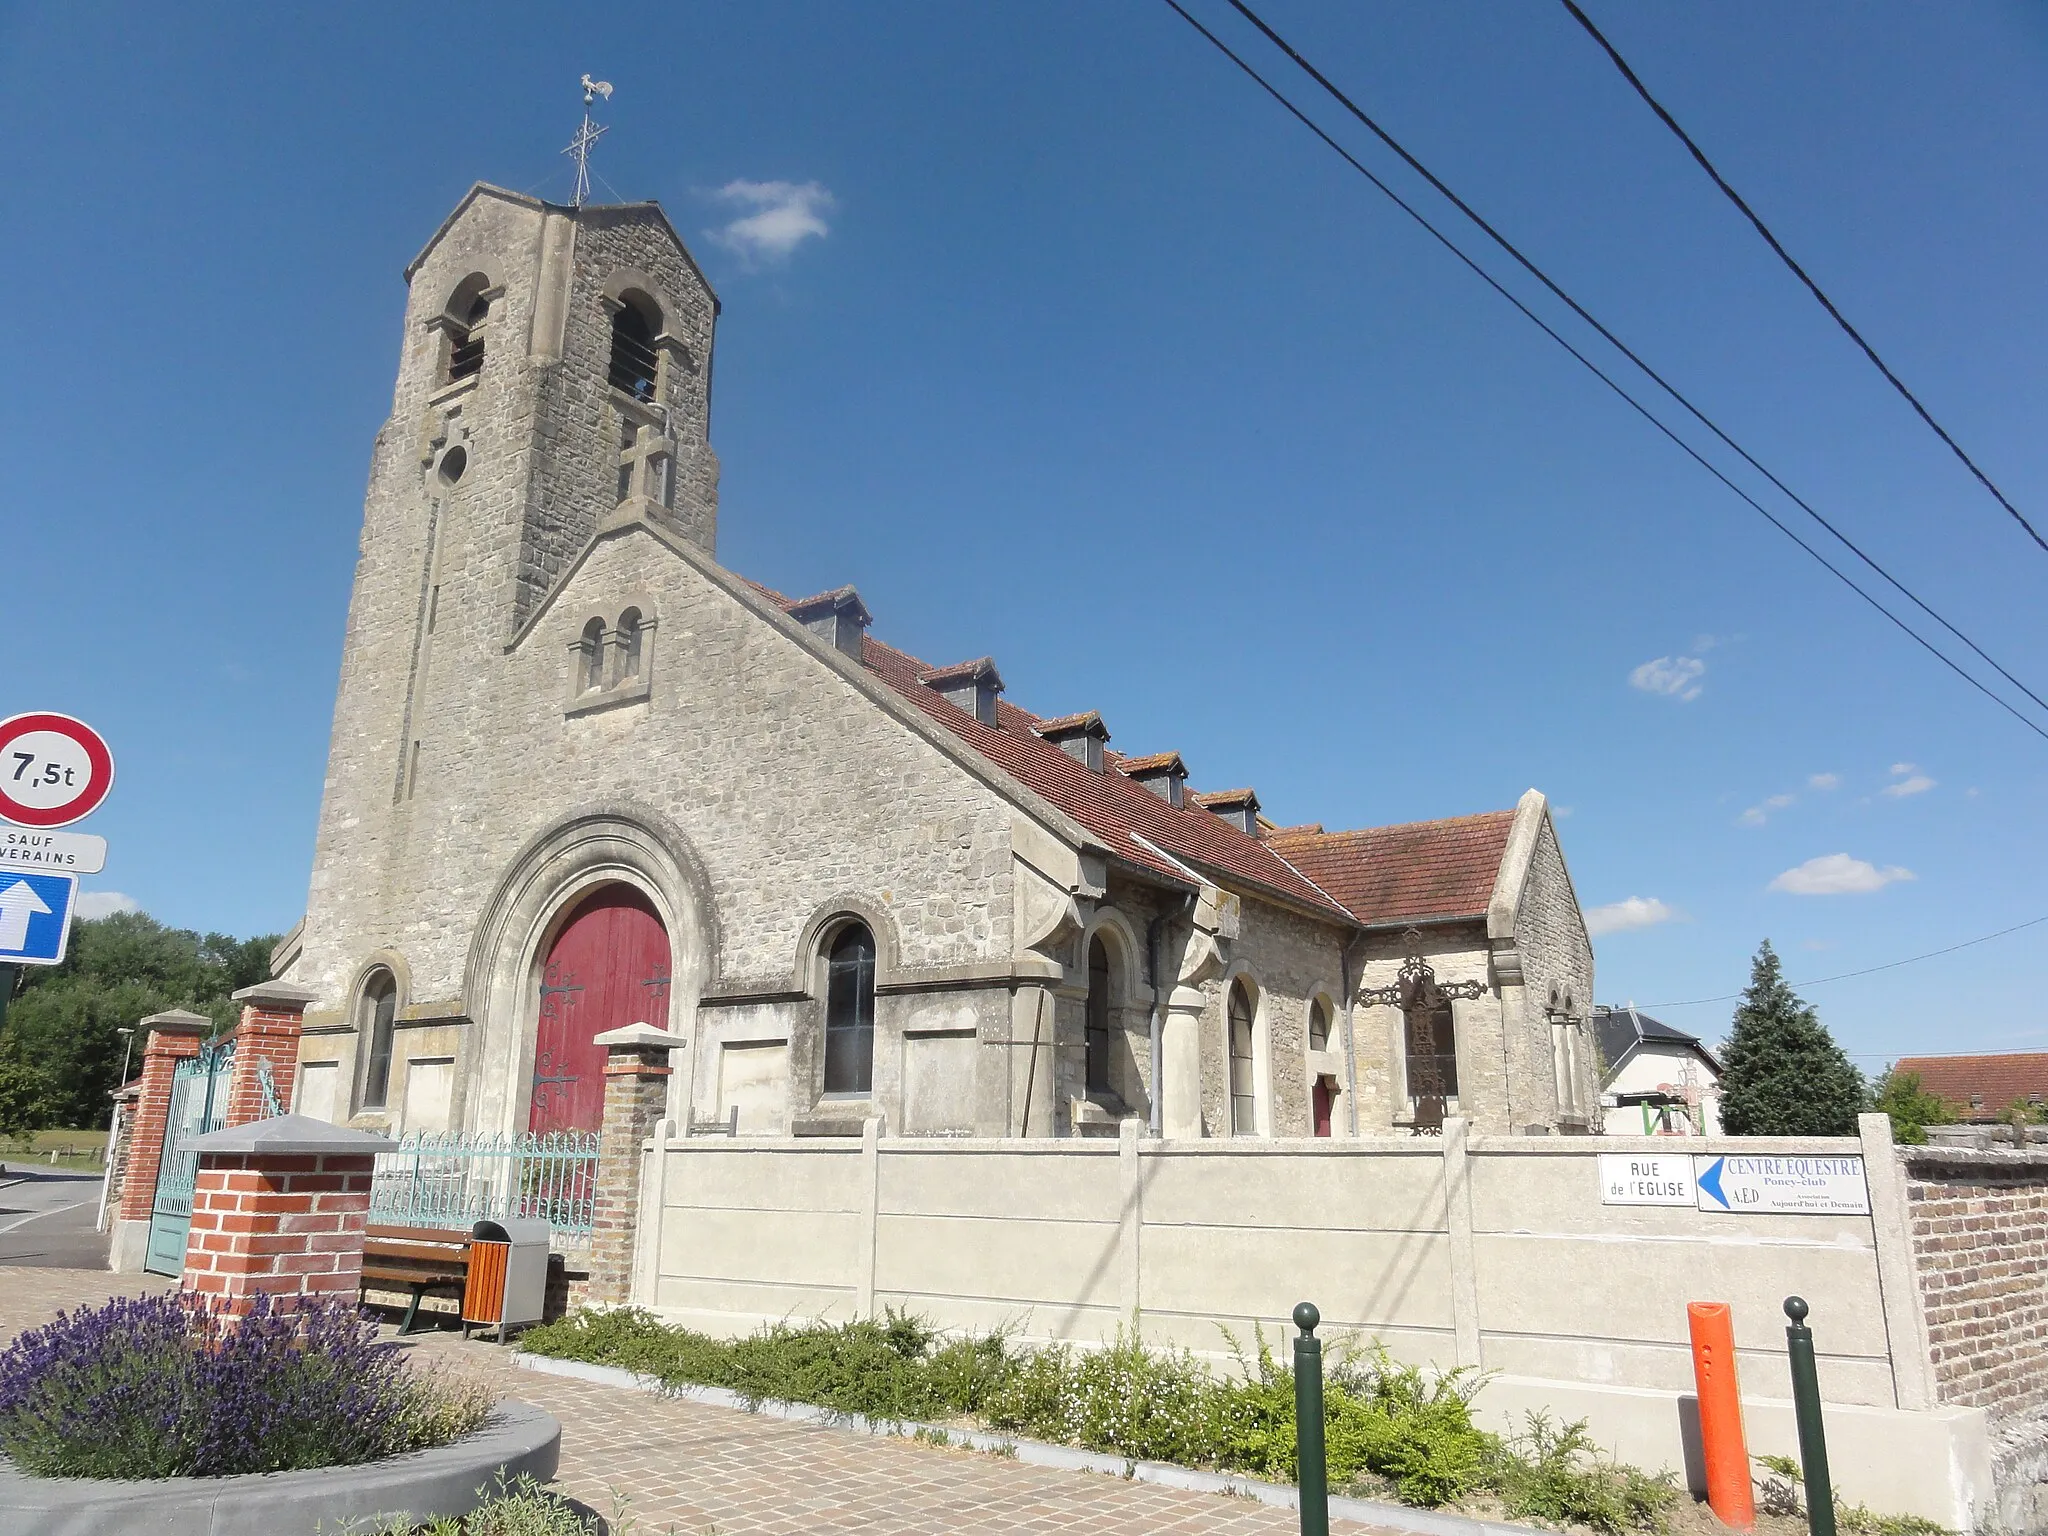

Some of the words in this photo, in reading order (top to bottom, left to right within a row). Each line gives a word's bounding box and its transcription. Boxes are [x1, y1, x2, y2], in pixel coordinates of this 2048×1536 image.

[13, 752, 75, 788] 7,5t
[7, 833, 53, 847] SAUF
[1631, 1162, 1660, 1176] RUE
[1728, 1158, 1783, 1175] CENTRE
[1611, 1182, 1624, 1195] de
[1630, 1179, 1685, 1196] l'ÉGLISE
[1764, 1177, 1827, 1188] Poney-club
[1770, 1200, 1818, 1209] Aujourd'hui
[1831, 1201, 1864, 1209] Demain
